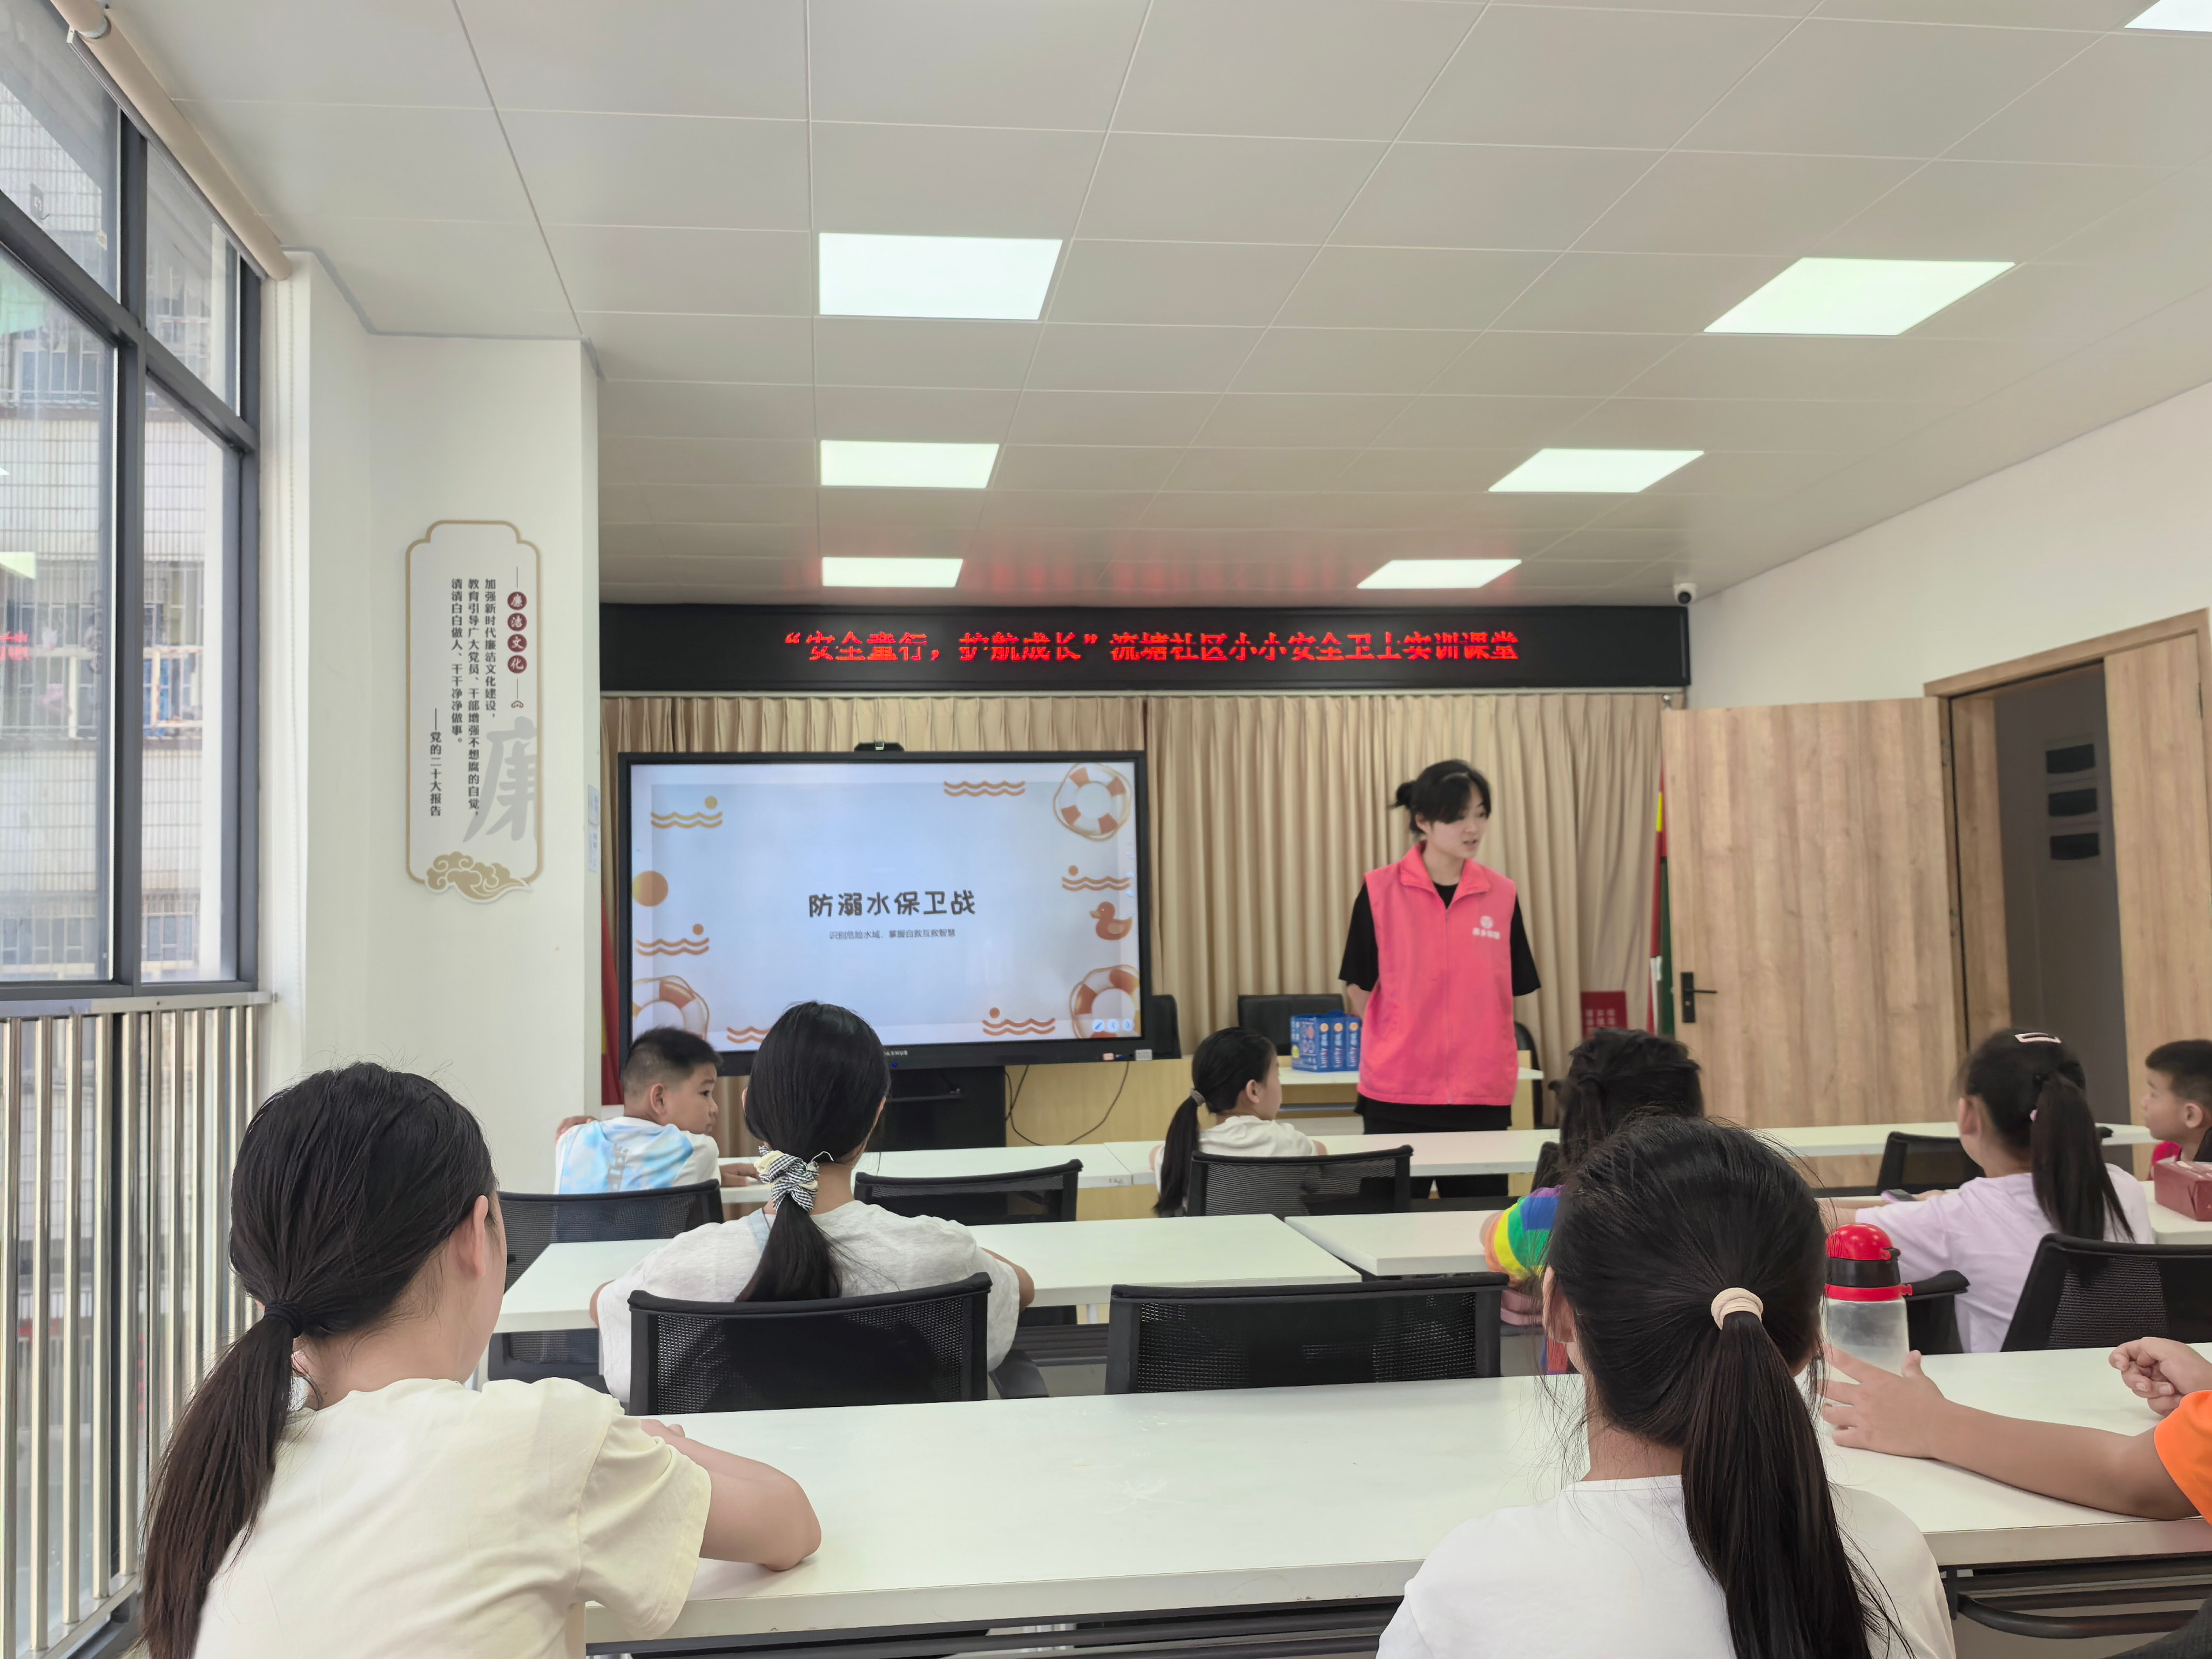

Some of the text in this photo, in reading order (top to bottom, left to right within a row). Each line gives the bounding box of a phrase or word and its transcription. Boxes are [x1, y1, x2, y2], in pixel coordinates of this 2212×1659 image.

[485, 579, 496, 718] 加强新时代廉洁文化建设，
[509, 593, 525, 671] 廉洁文化
[809, 890, 975, 917] 防溺水保卫战
